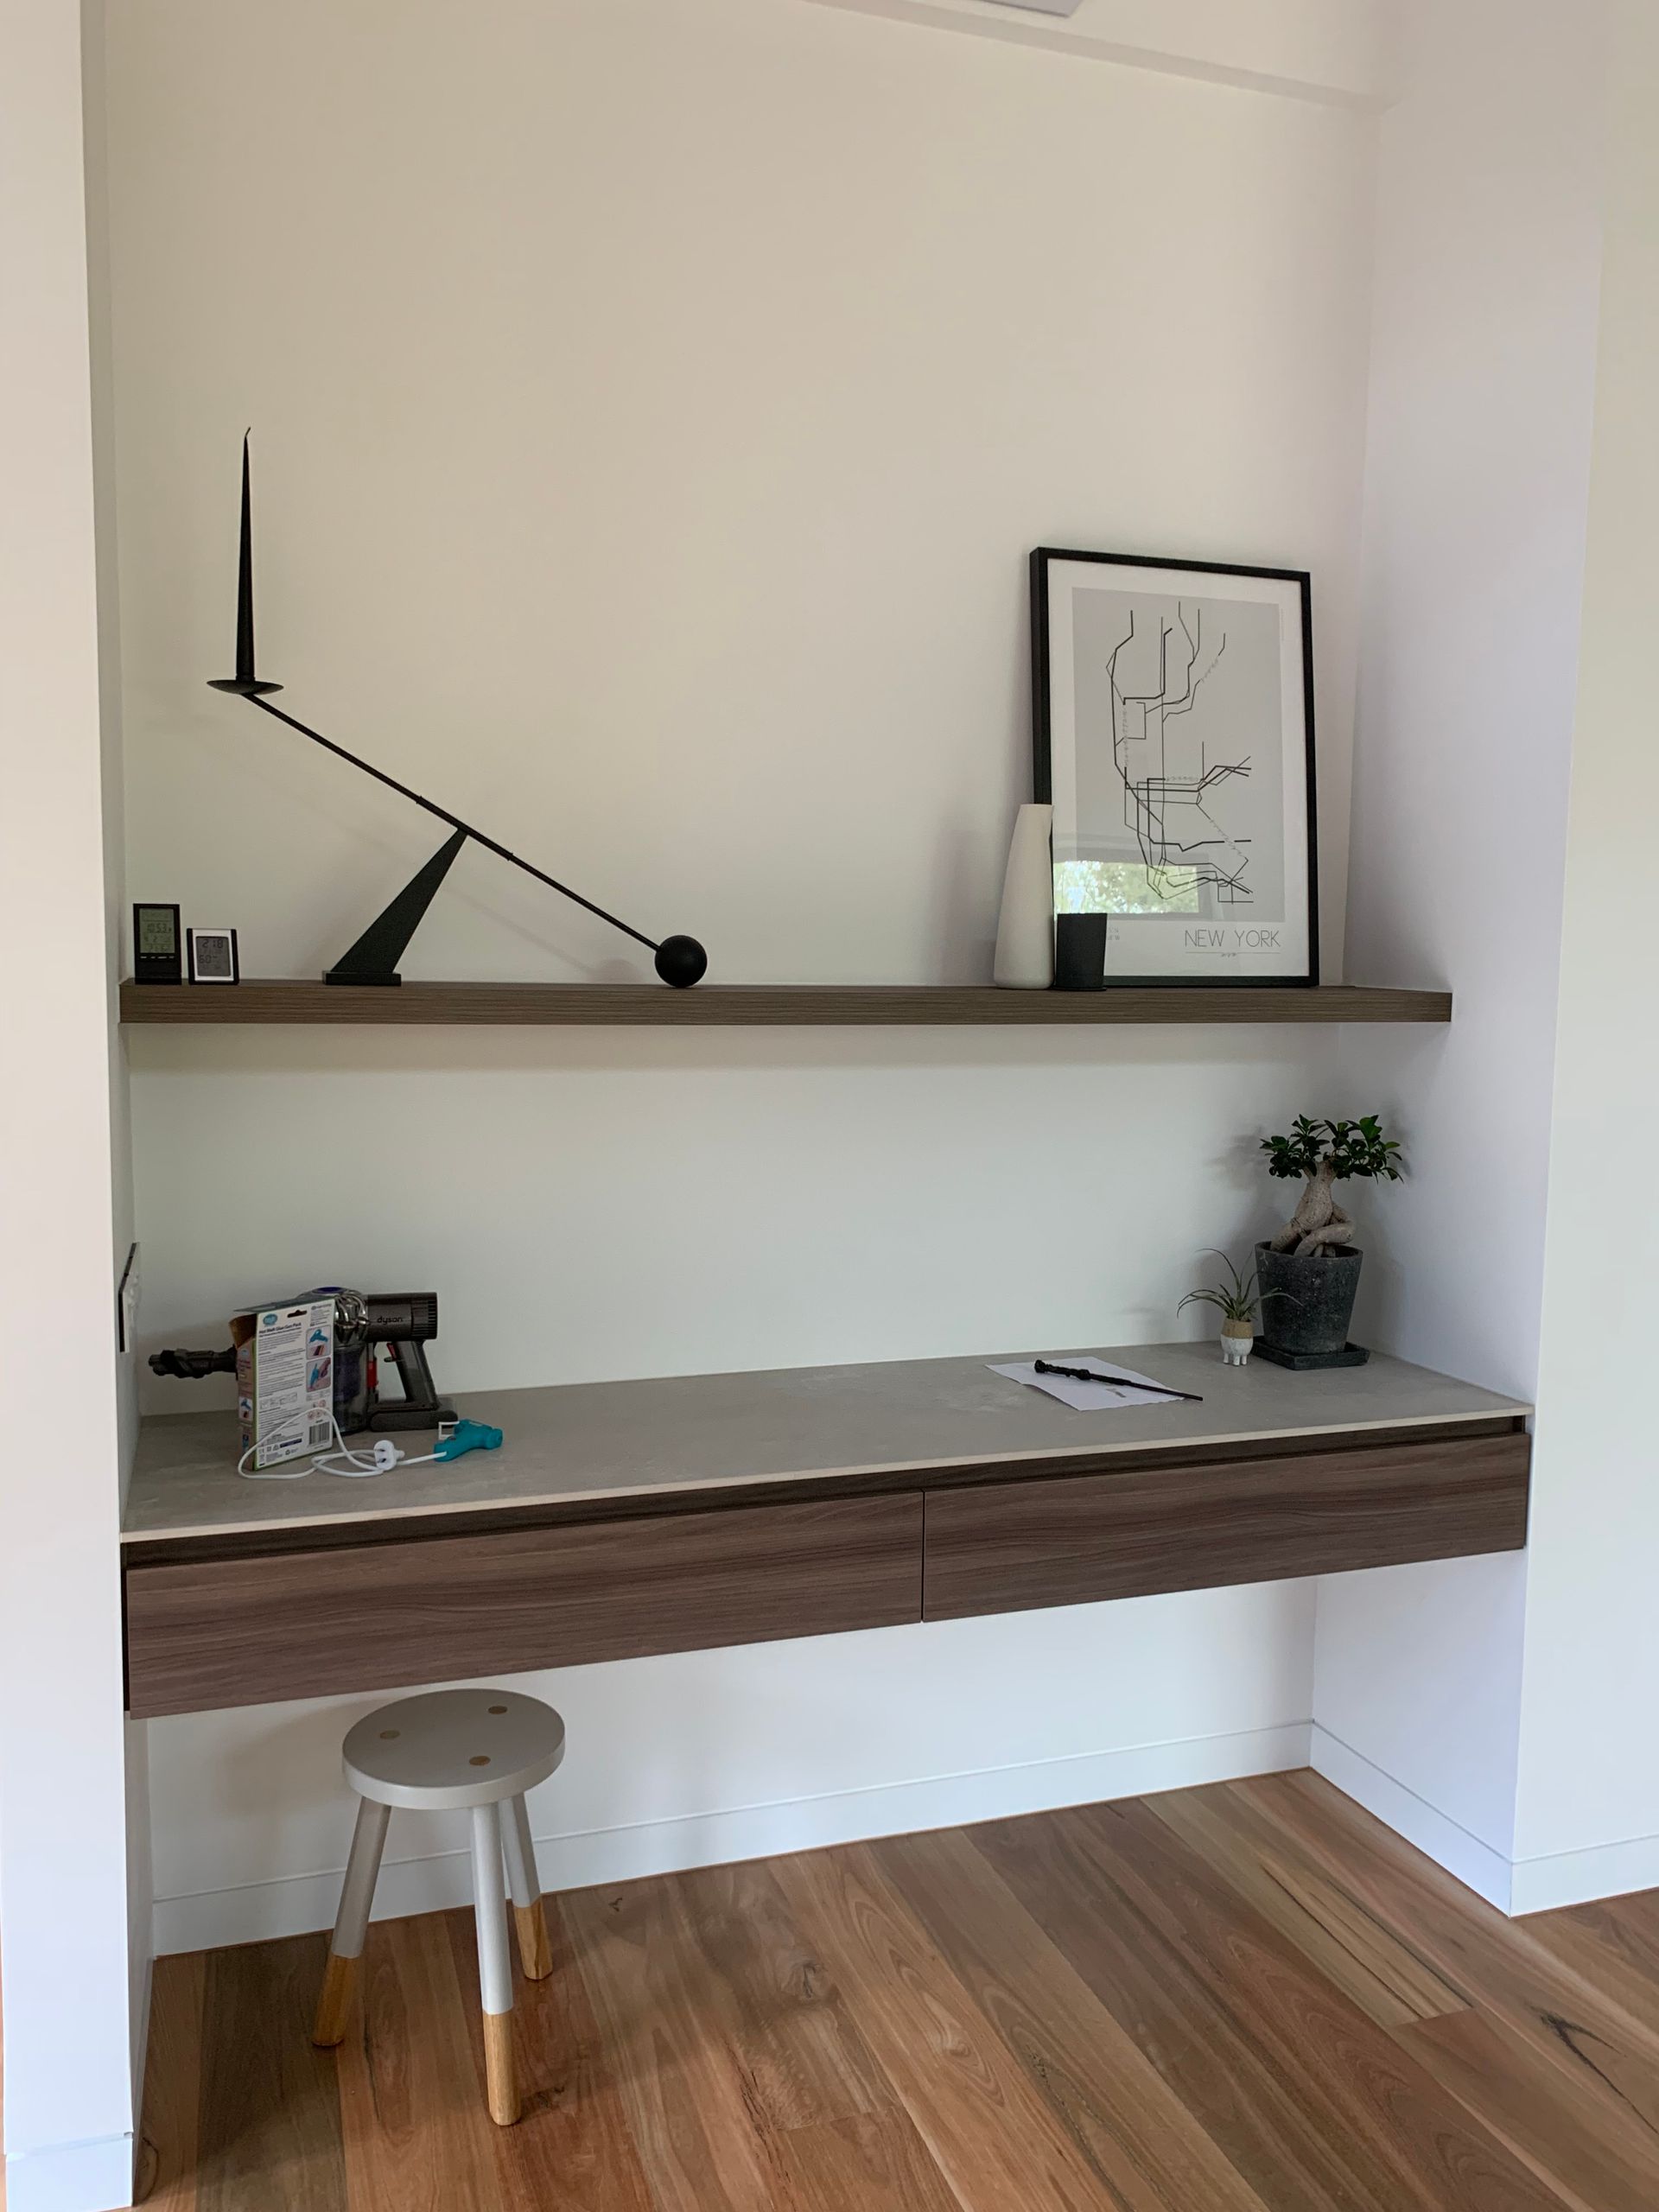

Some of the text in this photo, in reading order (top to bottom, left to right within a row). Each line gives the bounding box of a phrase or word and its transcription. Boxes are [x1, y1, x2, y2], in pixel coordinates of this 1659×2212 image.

[1185, 929, 1281, 948] NEW YORK
[377, 1315, 403, 1325] dyson
